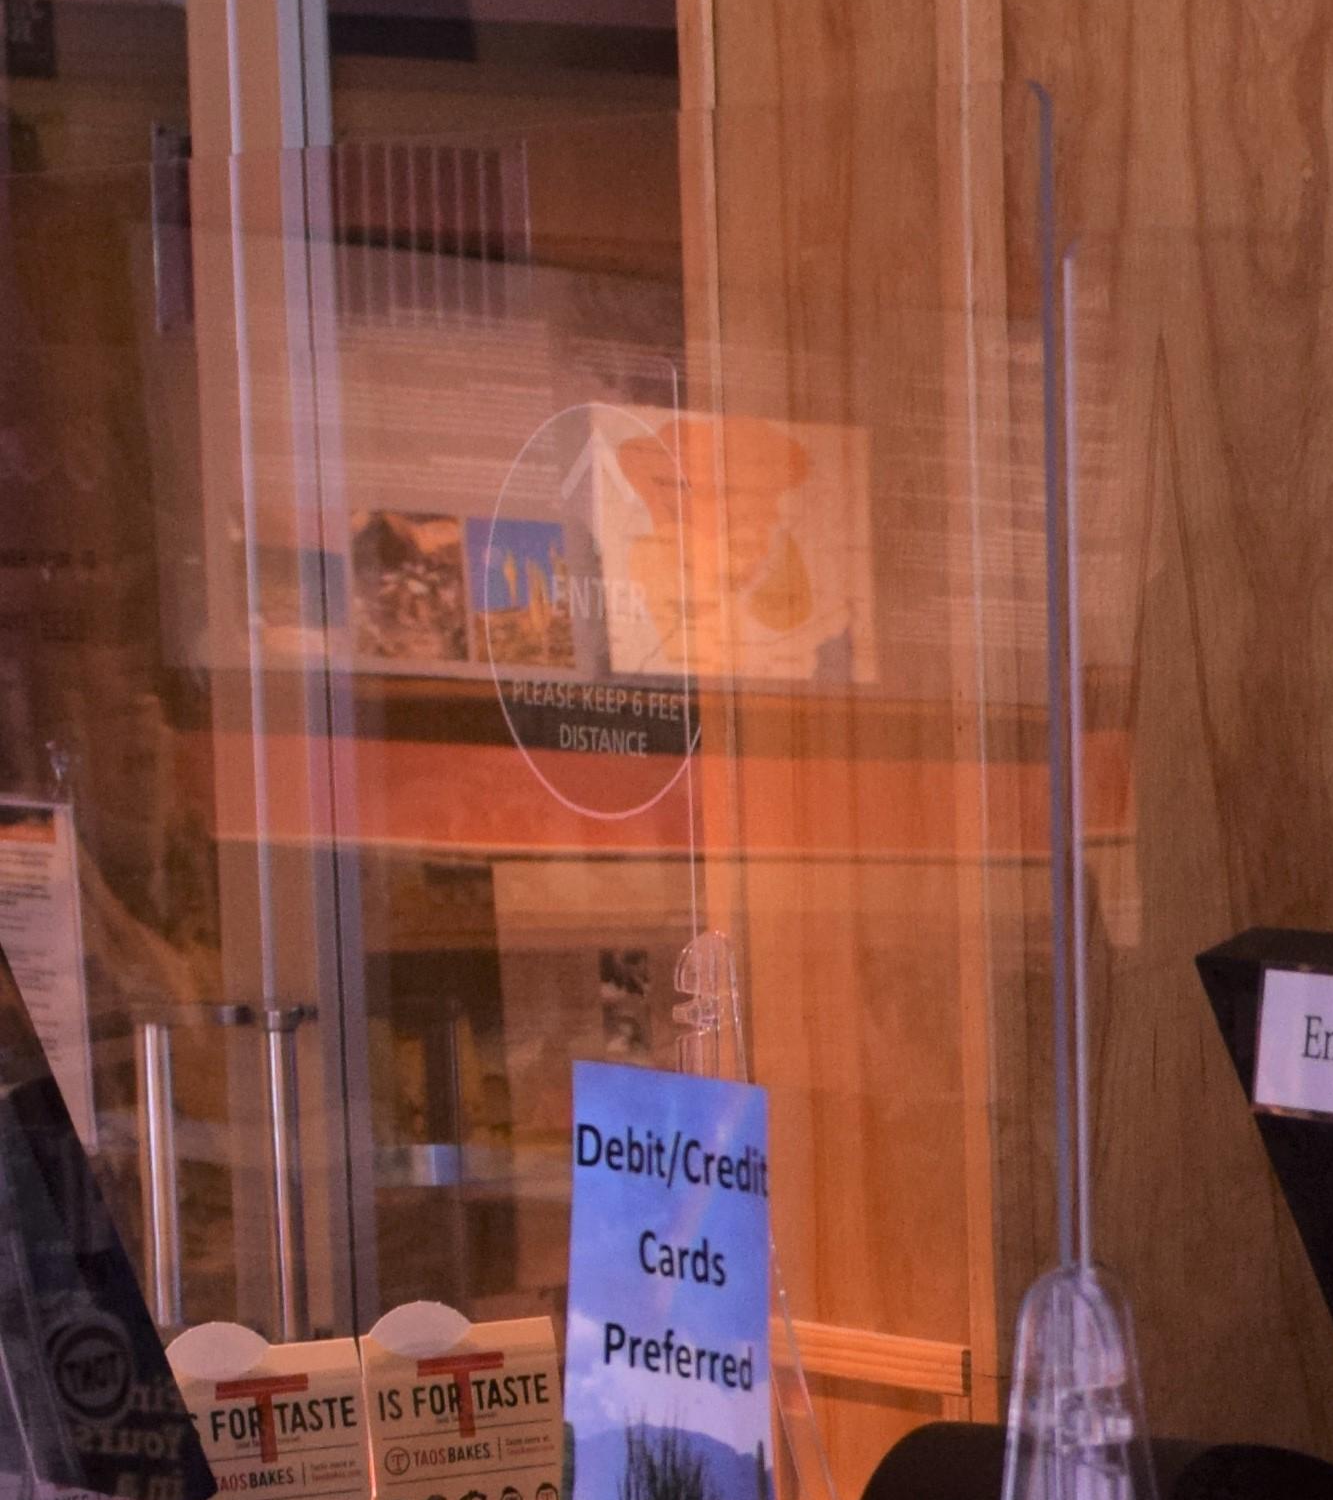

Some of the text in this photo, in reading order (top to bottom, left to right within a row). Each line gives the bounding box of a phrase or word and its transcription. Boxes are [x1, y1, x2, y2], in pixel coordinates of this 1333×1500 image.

[551, 573, 650, 624] ENTER
[512, 679, 576, 710] PLEASE
[582, 685, 627, 715] KEEP
[631, 690, 643, 717] 6
[558, 721, 648, 758] DISTANCE
[638, 1229, 727, 1288] Cards
[603, 1322, 753, 1393] Preferred
[209, 1404, 265, 1442] FOR
[273, 1396, 358, 1435] TASTE
[377, 1373, 550, 1421] IS FOR TASTE
[413, 1442, 491, 1468] TAOSBAKES
